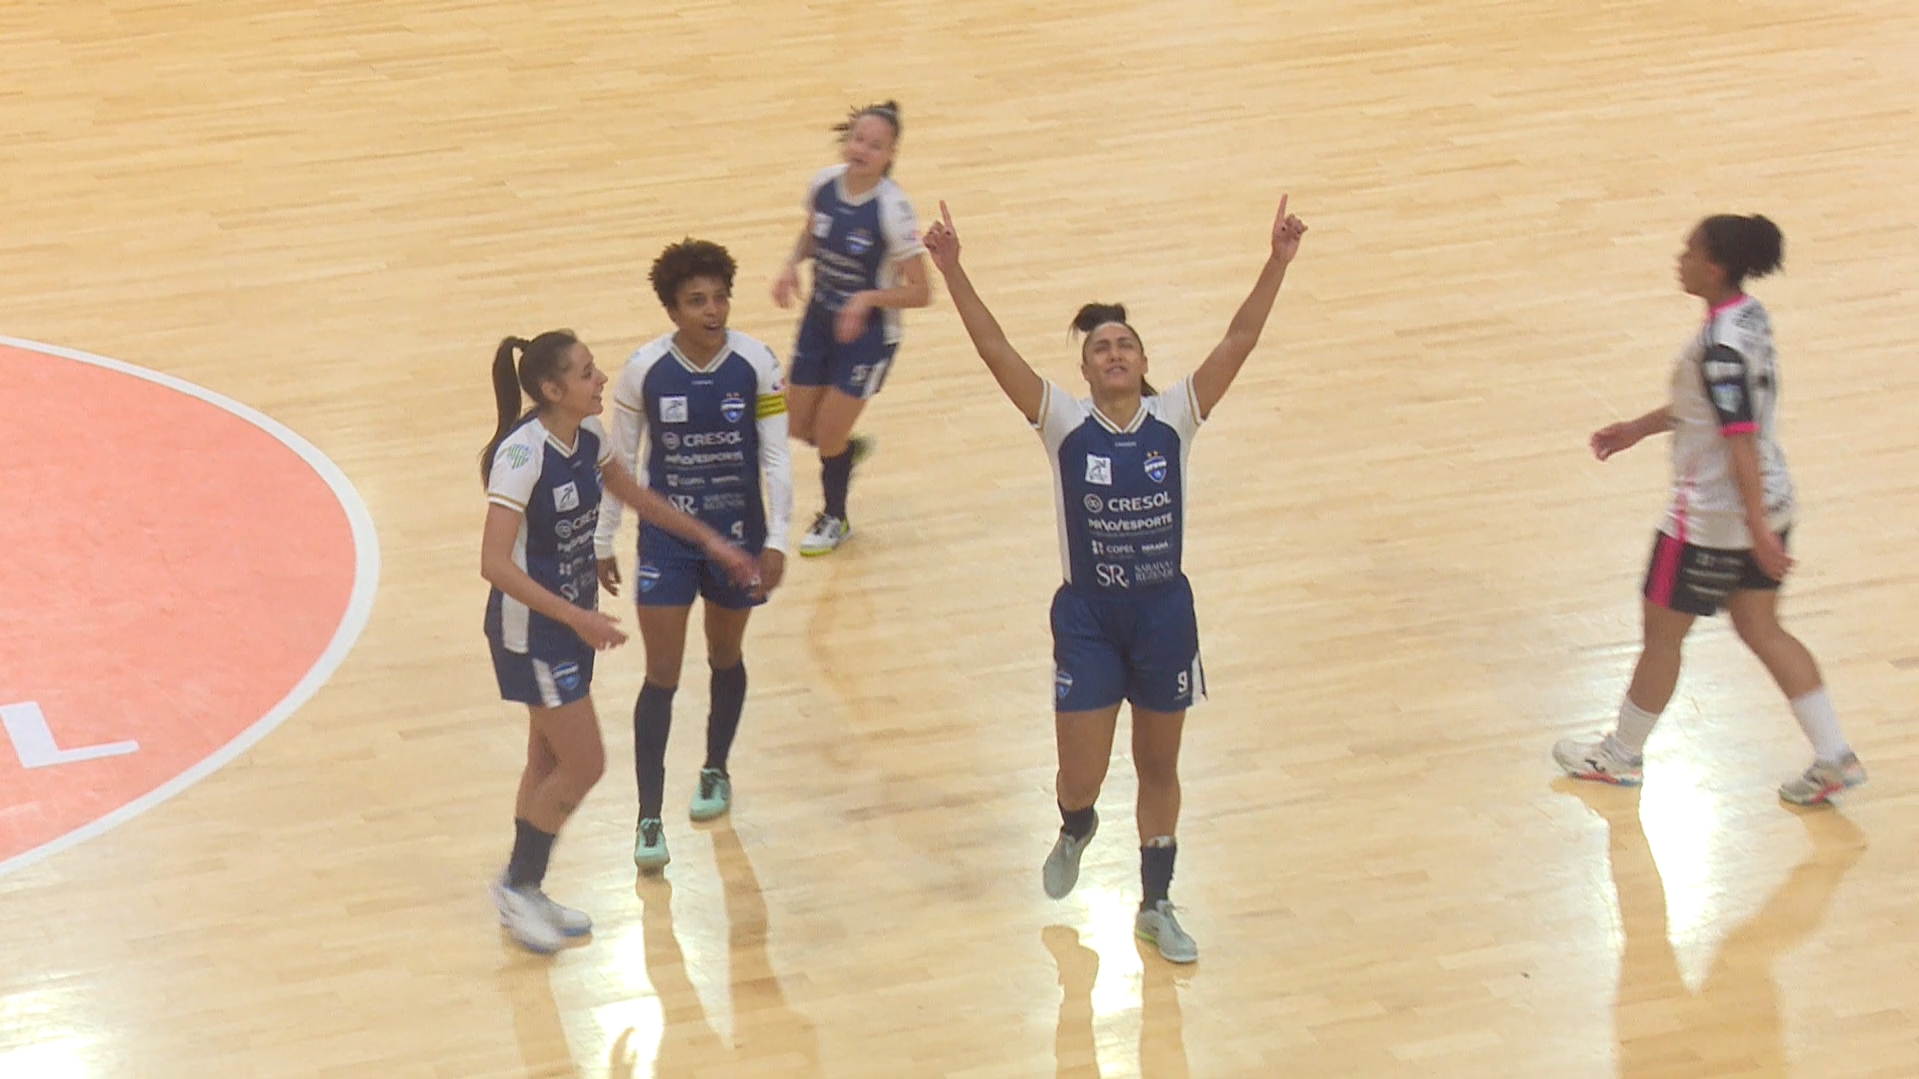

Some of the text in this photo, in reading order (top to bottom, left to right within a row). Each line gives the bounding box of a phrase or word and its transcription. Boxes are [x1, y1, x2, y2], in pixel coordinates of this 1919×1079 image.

[682, 431, 742, 448] CRESOL
[1107, 491, 1172, 512] CRESOL
[1105, 544, 1136, 554] COPEL
[1095, 562, 1130, 588] SR
[1177, 669, 1189, 694] 9
